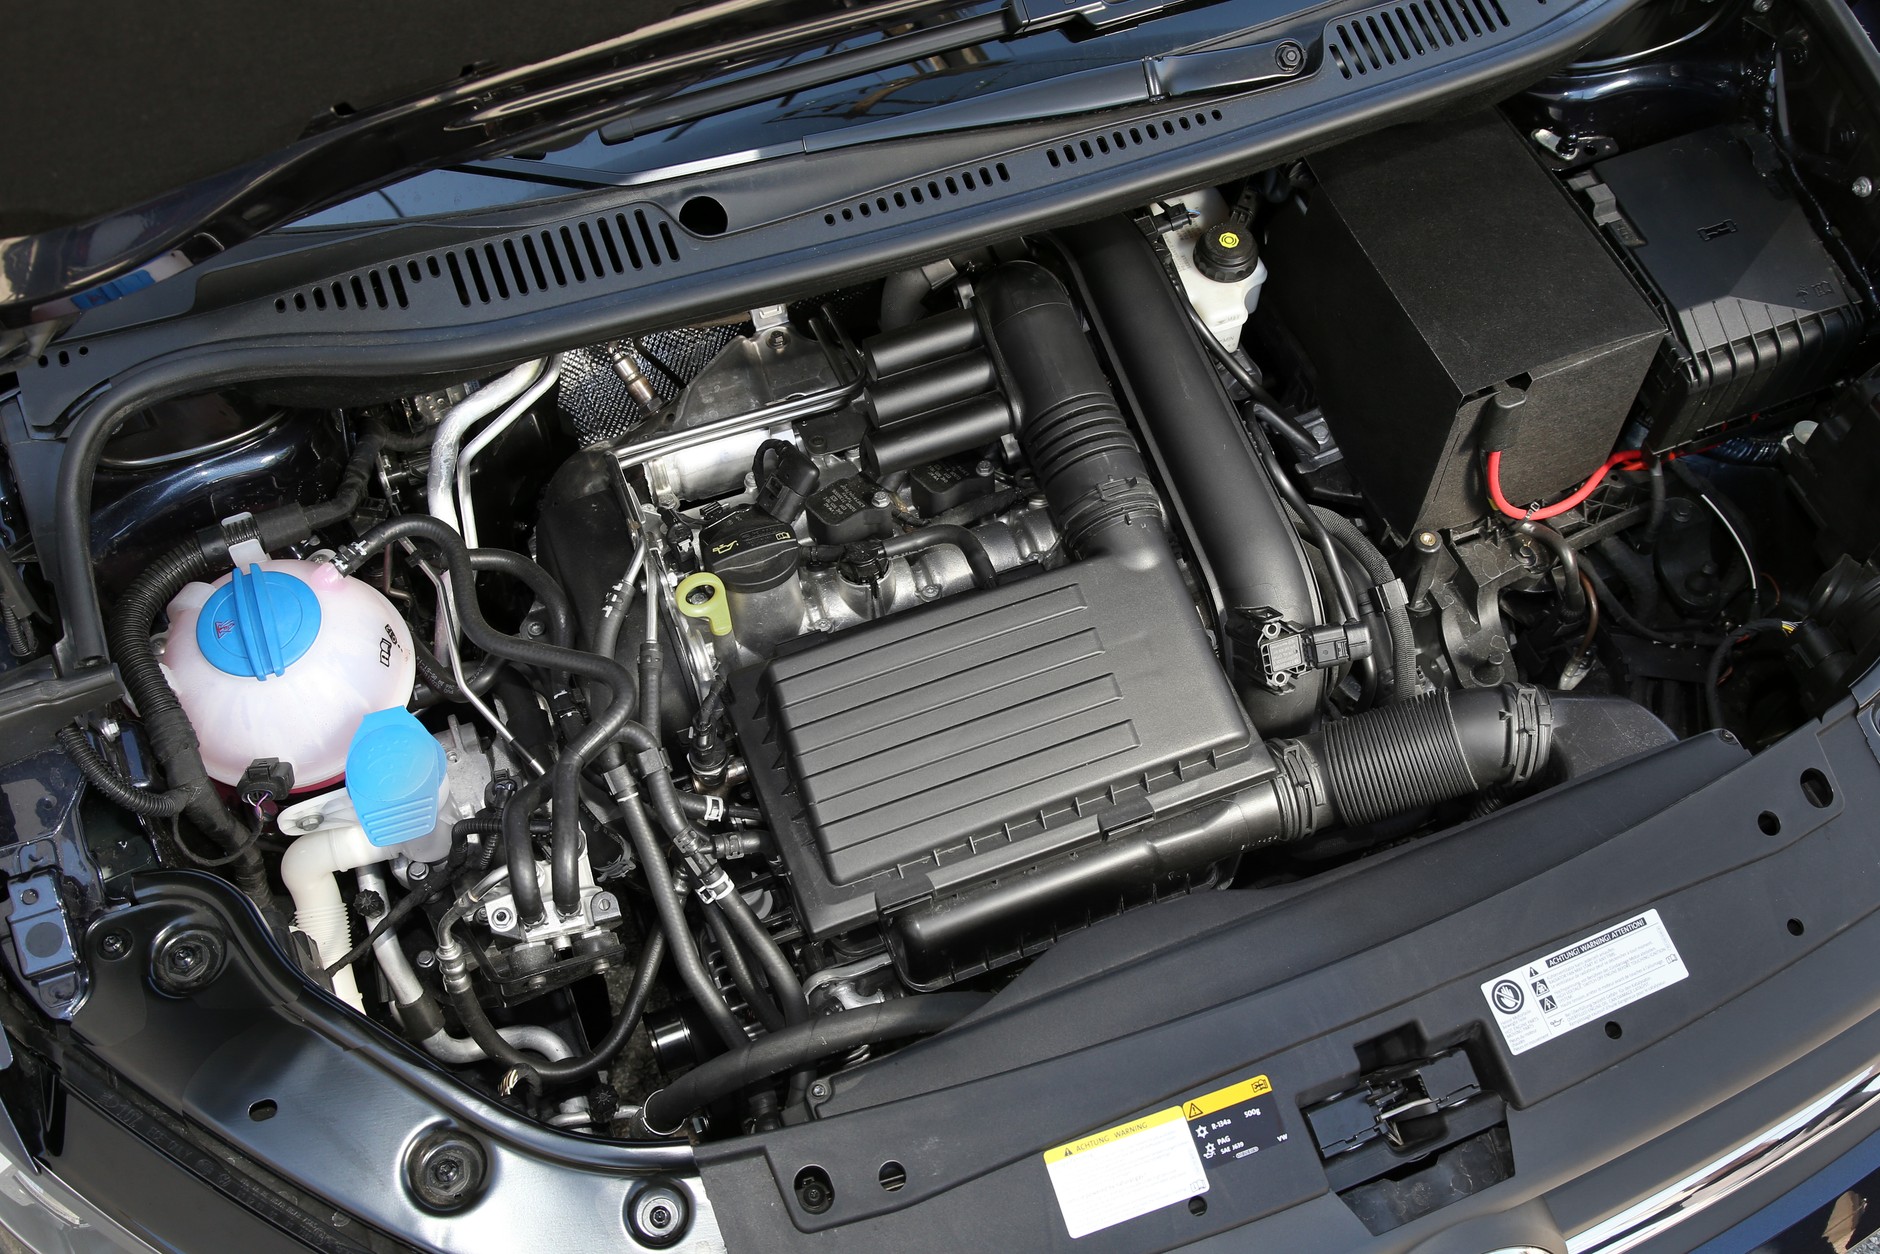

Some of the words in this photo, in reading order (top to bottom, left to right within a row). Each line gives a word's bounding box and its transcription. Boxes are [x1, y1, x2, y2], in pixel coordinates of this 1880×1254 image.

[1549, 947, 1580, 967] ACHTUNG!
[1580, 934, 1611, 953] WARNING!
[1611, 918, 1645, 939] ATTENTION!
[1243, 1107, 1261, 1119] 500g
[1211, 1118, 1232, 1130] R-134a
[1076, 1135, 1110, 1152] ACHTUNG
[1114, 1121, 1148, 1139] WARNING
[1217, 1135, 1231, 1146] PAG
[1276, 1133, 1288, 1142] VW
